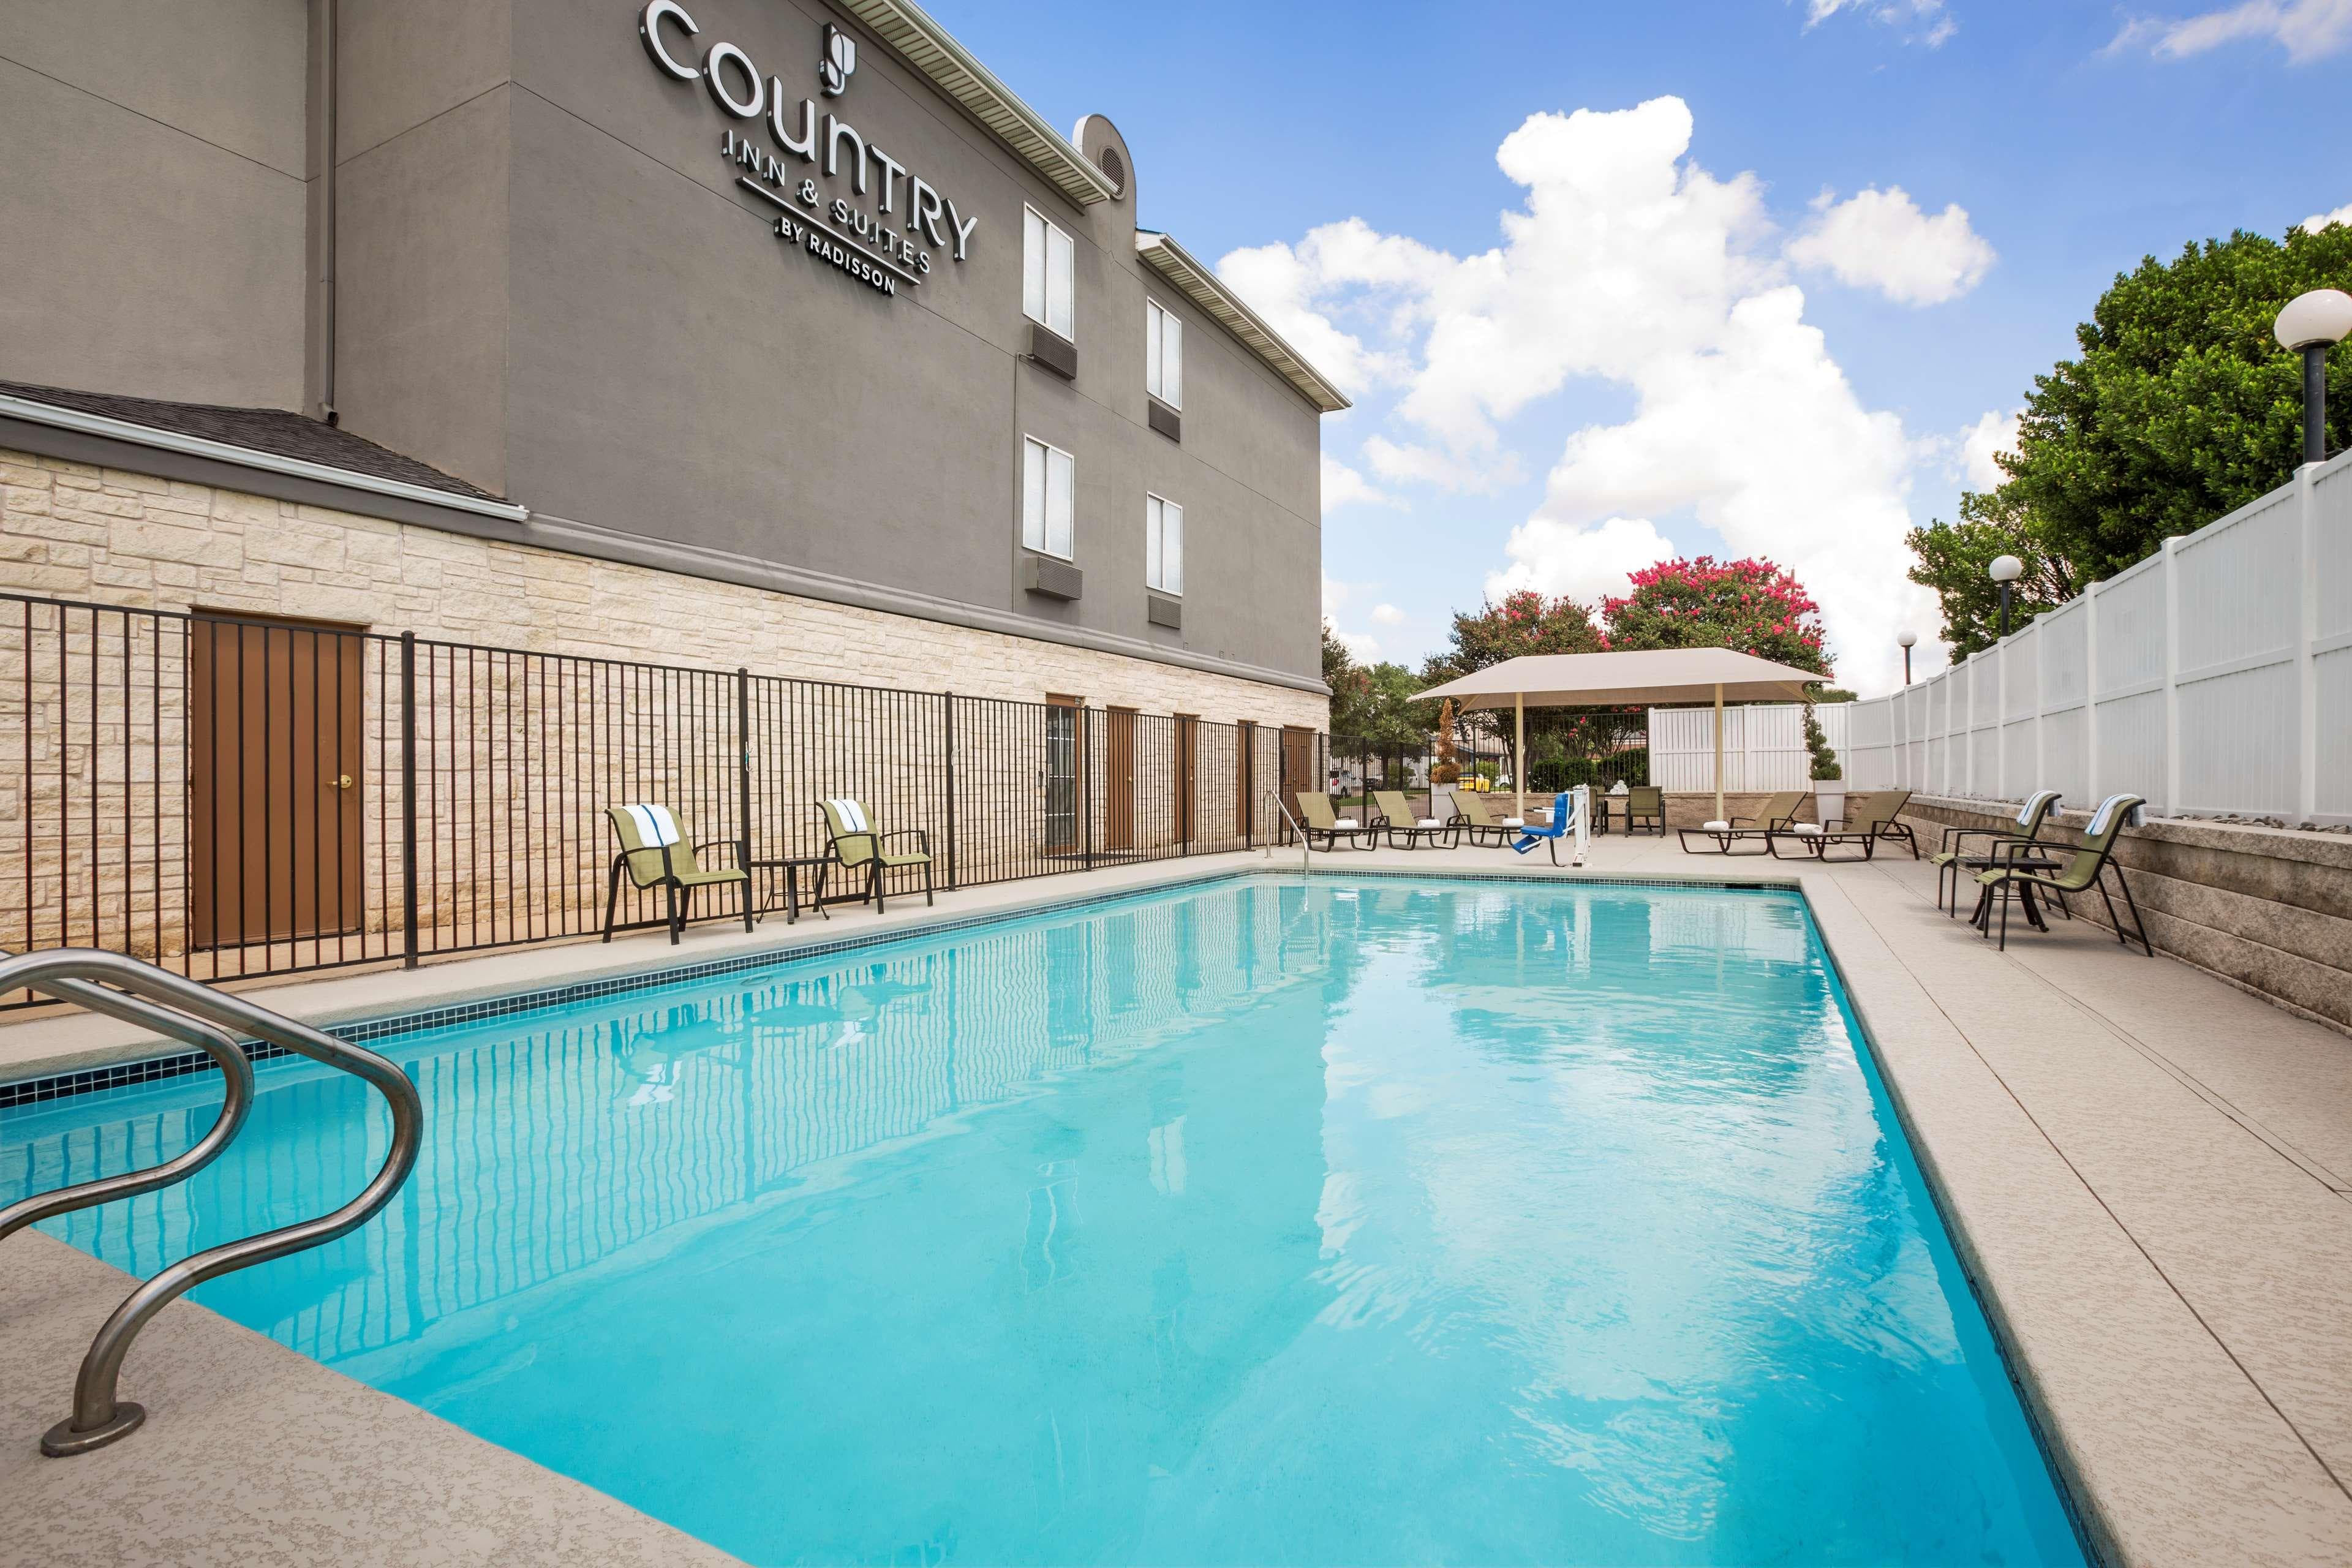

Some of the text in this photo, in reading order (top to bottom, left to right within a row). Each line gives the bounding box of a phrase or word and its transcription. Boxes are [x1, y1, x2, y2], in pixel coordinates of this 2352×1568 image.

[723, 129, 930, 274] INN & SUITES
[779, 216, 895, 296] BY RADISSON
